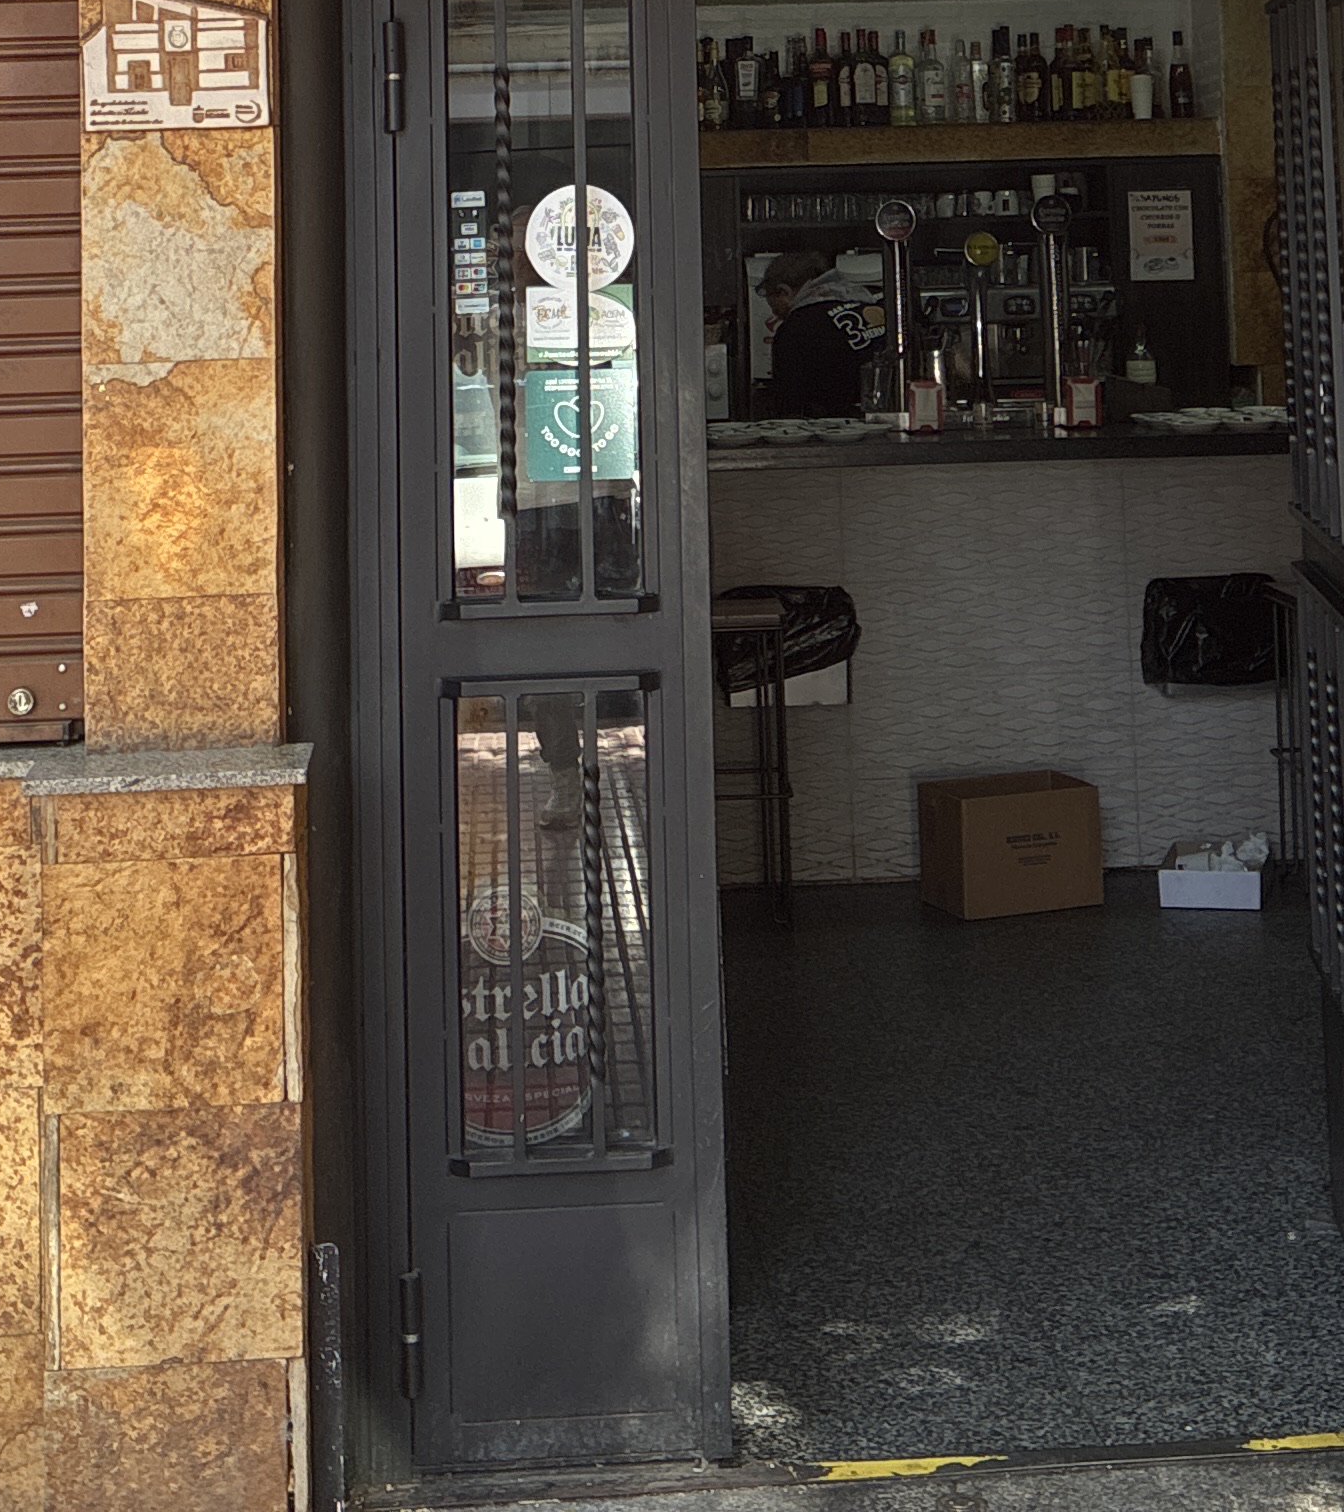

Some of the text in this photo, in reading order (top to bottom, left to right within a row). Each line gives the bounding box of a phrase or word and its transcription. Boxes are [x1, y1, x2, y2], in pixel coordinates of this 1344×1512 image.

[860, 324, 886, 341] HERM
[541, 425, 560, 448] TOO
[593, 438, 607, 453] TO
[605, 423, 620, 441] GO
[461, 968, 590, 1022] strella
[467, 1019, 587, 1072] alcia
[465, 1085, 580, 1104] RVEZA SPECIAL
